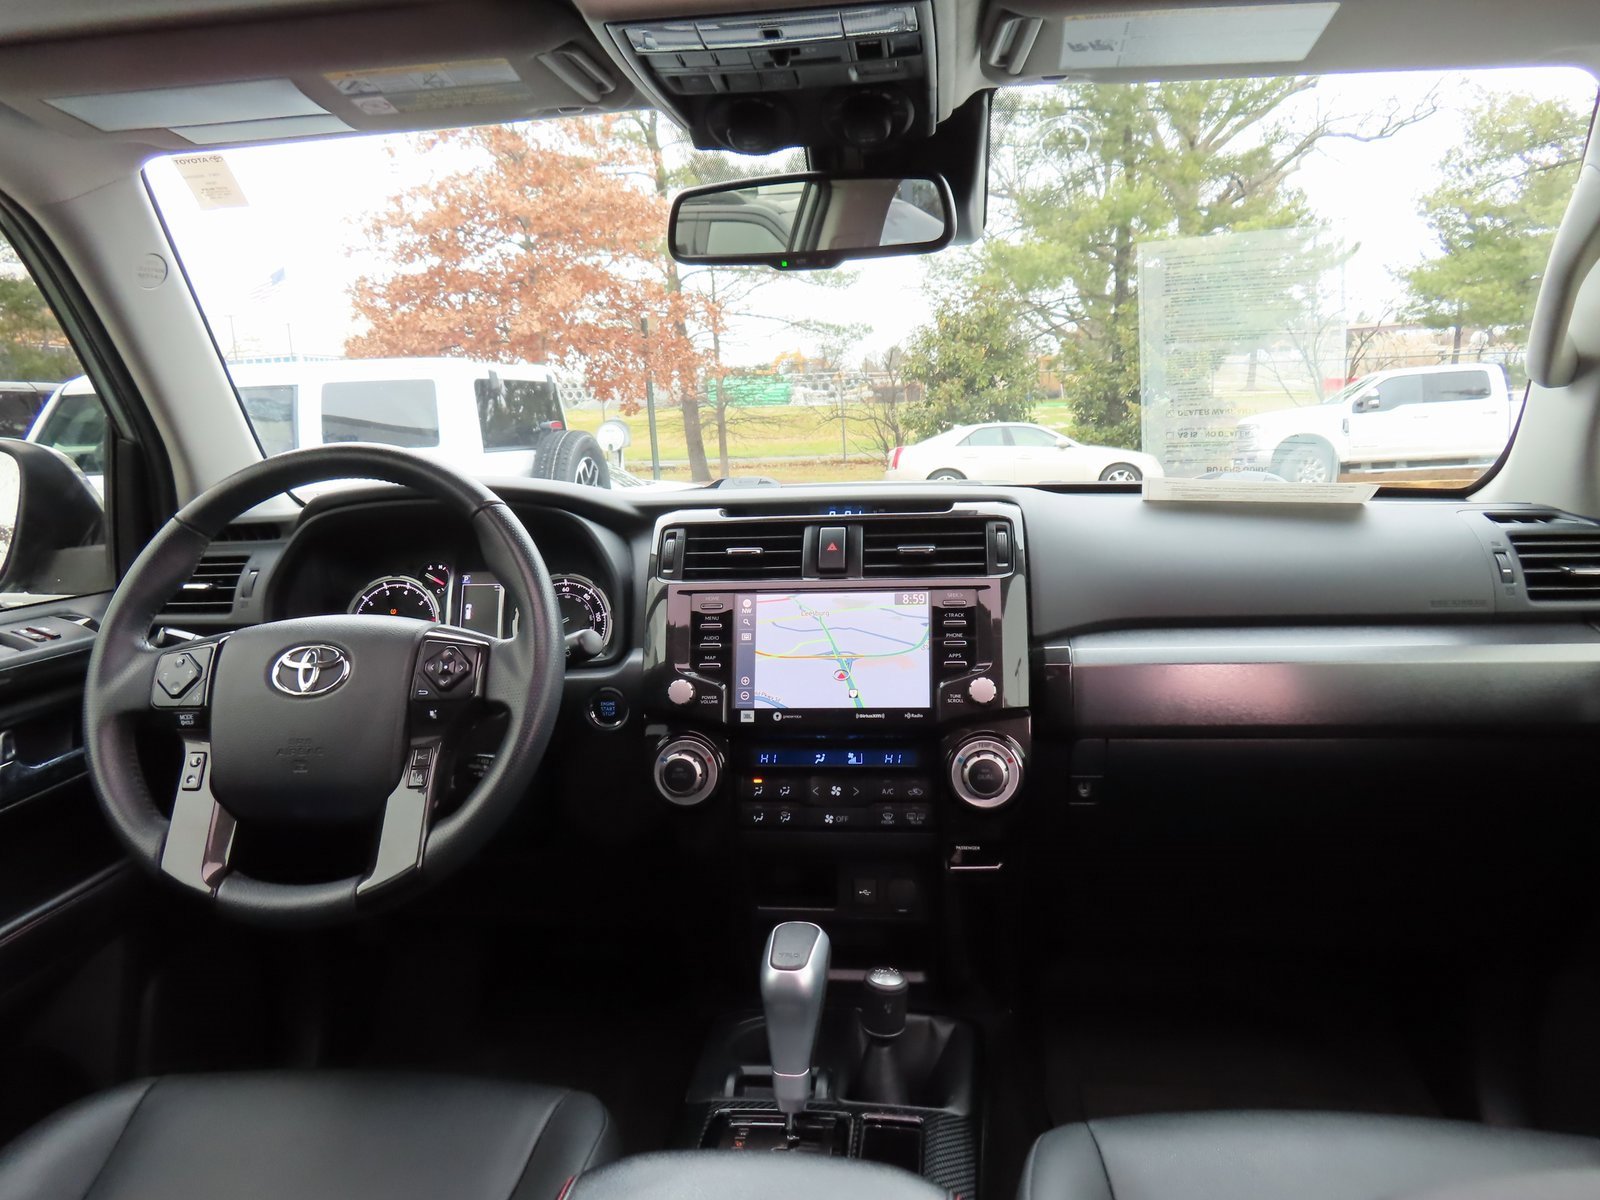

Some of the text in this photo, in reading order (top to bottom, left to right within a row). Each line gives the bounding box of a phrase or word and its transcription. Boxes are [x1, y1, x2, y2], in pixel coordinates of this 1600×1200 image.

[174, 157, 209, 165] TOYOTA
[902, 593, 925, 604] 8:59
[800, 609, 830, 618] Leesburg
[835, 815, 849, 823] OFF
